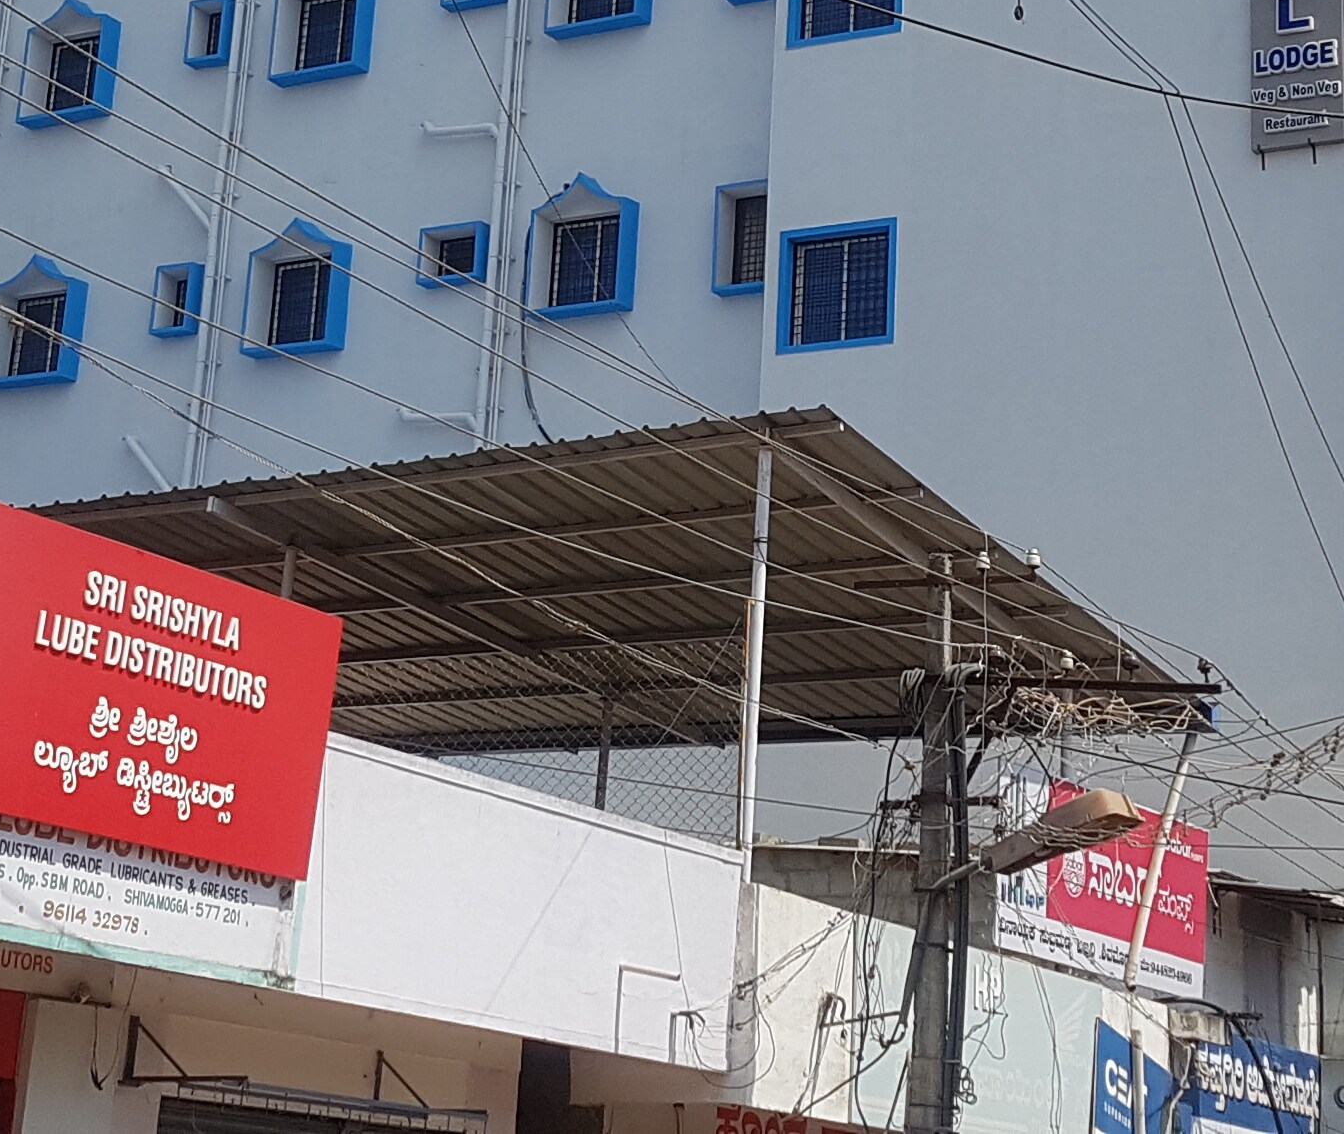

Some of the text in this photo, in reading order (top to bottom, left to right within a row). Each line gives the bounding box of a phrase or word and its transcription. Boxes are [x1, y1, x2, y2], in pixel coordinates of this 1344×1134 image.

[1254, 39, 1338, 77] LODGE
[1252, 79, 1342, 105] Veg & Non Veg
[1264, 109, 1329, 133] Restaurant
[85, 570, 241, 651] SRI SRISHYLA
[35, 610, 268, 709] LUBE DISTRIBUTORS
[90, 696, 198, 764] ಶ್ರೀ ಶ್ರೀಶೈಲ
[34, 740, 109, 793] ಲ್ಯೂಬ್
[63, 853, 103, 876] GRADE
[111, 861, 184, 892] LUBRICANTS
[188, 880, 197, 893] &
[43, 900, 88, 925] 96114
[92, 910, 140, 934] 32978
